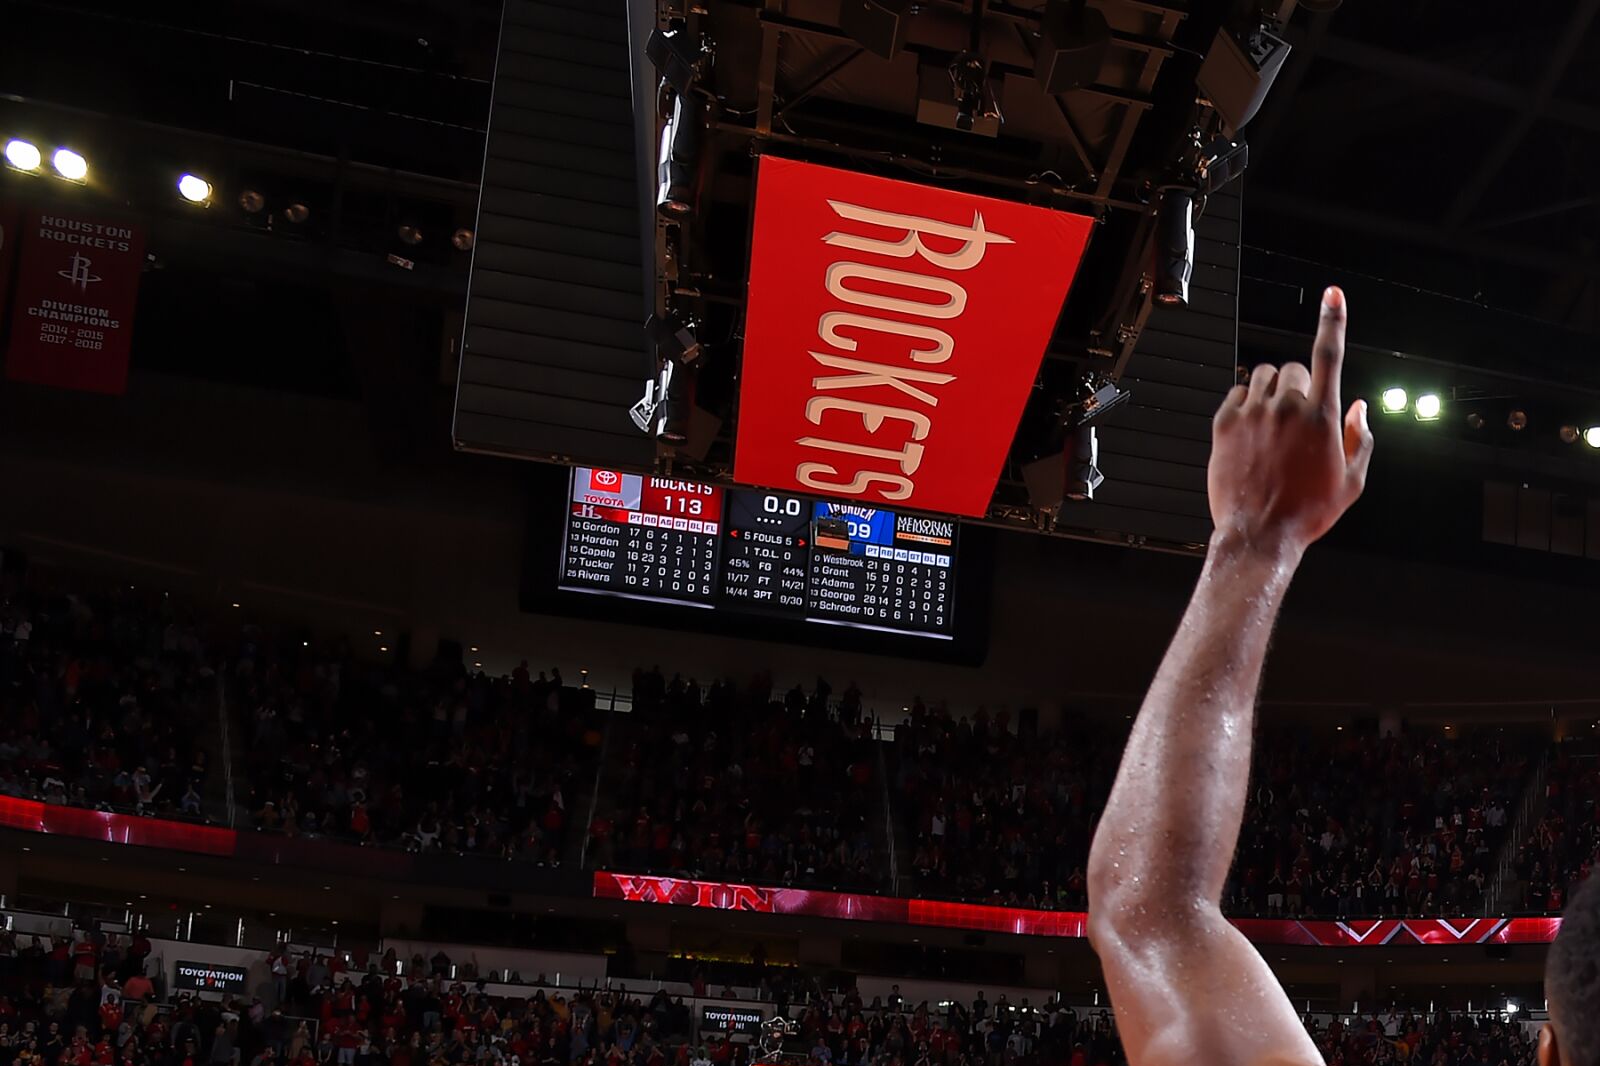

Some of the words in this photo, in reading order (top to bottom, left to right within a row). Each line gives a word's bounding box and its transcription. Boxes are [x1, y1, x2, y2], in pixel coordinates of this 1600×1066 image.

[41, 215, 132, 239] HOUSTON
[39, 228, 129, 252] ROCKETS
[42, 300, 109, 318] DIVISION
[27, 308, 120, 329] CHAMPIONS
[40, 323, 68, 335] 2014
[77, 328, 104, 341] 2015
[794, 199, 1016, 501] ROCKETS
[584, 494, 624, 507] TOYOTA
[664, 495, 702, 515] 113
[764, 495, 801, 516] 0.0
[582, 521, 620, 536] Gordon
[630, 528, 640, 536] 17
[581, 533, 619, 547] Harden
[628, 540, 640, 549] 41
[744, 531, 751, 540] 5
[753, 532, 782, 545] FOULS
[785, 537, 792, 546] 5
[580, 545, 616, 559] Capela
[641, 553, 654, 563] 23
[754, 547, 779, 559] T.O.L.
[579, 557, 614, 570] Tucker
[628, 563, 636, 572] 11
[729, 558, 750, 568] 45%
[759, 562, 771, 571] FG
[783, 567, 804, 577] 44%
[823, 555, 864, 568] Westbrook
[867, 560, 878, 569] 21
[578, 569, 610, 583] Rivers
[625, 575, 636, 585] 10
[727, 572, 749, 583] 11/17
[758, 576, 770, 585] FT
[781, 580, 804, 590] 14/21
[822, 565, 849, 578] Grant
[866, 572, 877, 581] 15
[821, 577, 855, 590] Adams
[866, 583, 876, 592] 17
[725, 586, 748, 597] 14/44
[753, 590, 772, 600] 3PT
[780, 595, 803, 606] 9/30
[820, 589, 855, 602] George
[863, 594, 876, 604] 28
[878, 596, 889, 606] 14
[819, 600, 861, 614] Schroder
[863, 606, 874, 616] 10
[611, 873, 779, 913] WIN
[179, 967, 243, 981] TOYOTATHON
[195, 978, 205, 986] IS
[705, 1012, 760, 1022] TOYOTATHON
[719, 1021, 727, 1029] IS
